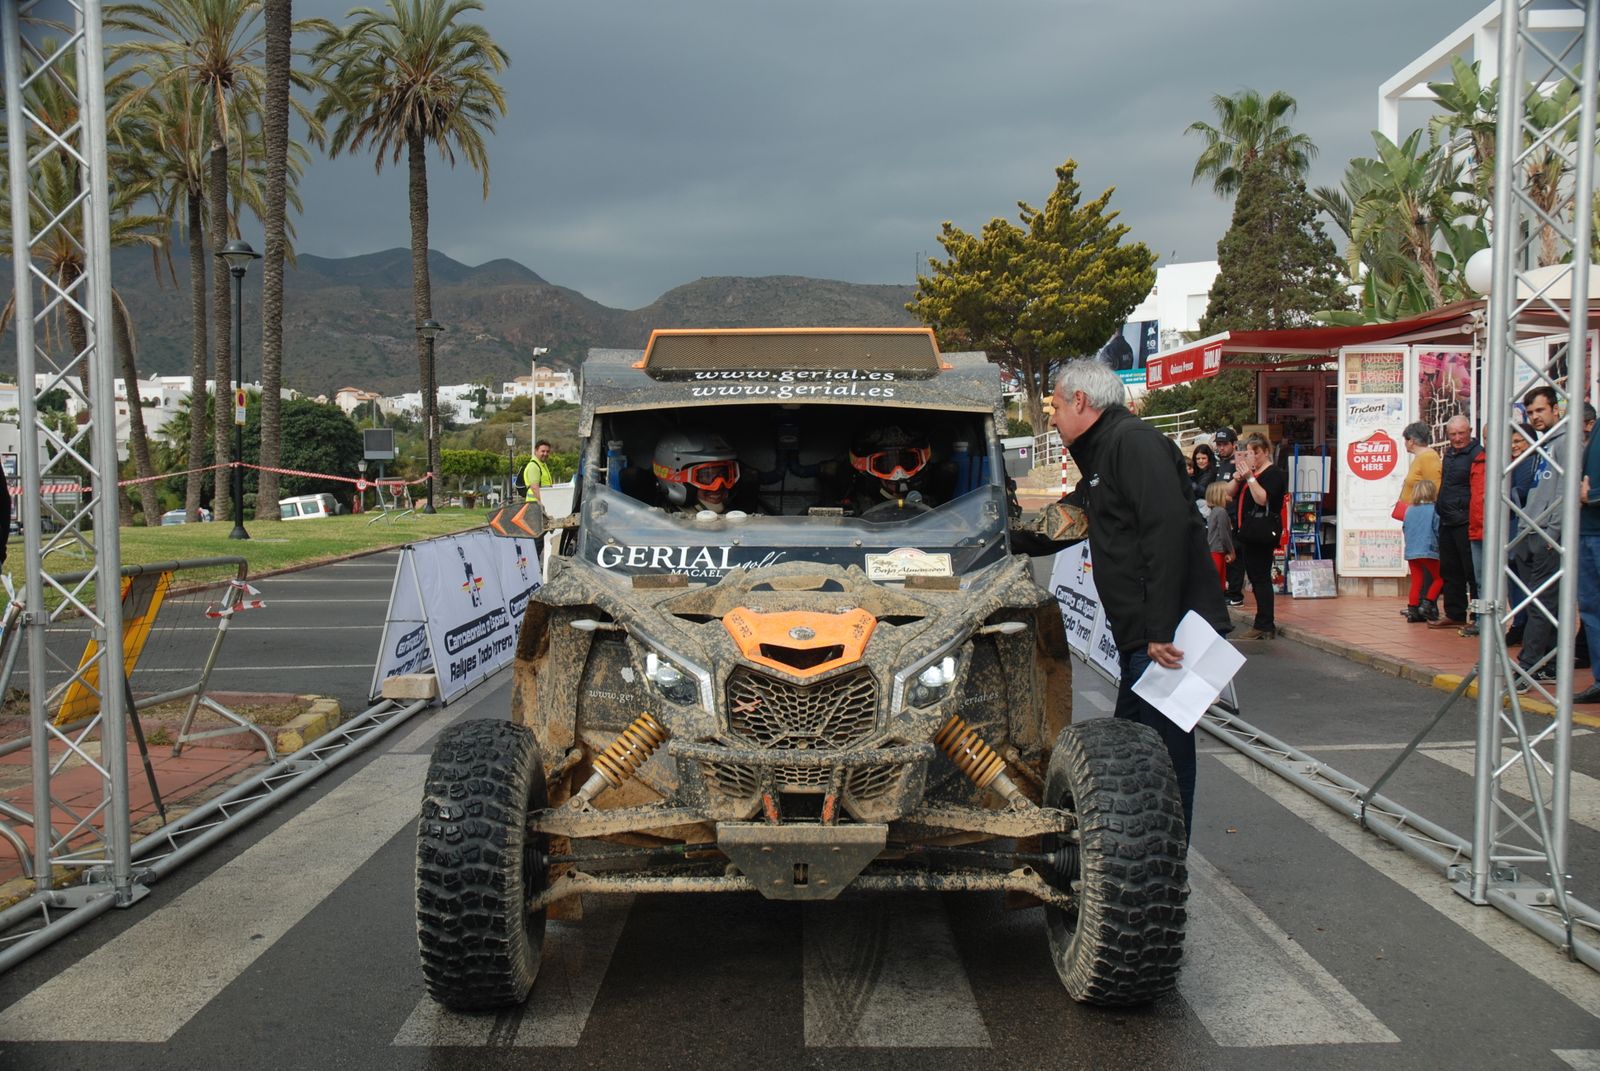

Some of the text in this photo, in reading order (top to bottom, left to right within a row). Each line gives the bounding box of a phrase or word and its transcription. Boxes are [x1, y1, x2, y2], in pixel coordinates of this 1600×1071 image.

[694, 369, 895, 382] www.gerial.es
[692, 382, 895, 399] www.gerial.es
[1349, 403, 1386, 415] Trident
[1353, 455, 1392, 463] ON SALE
[1361, 463, 1384, 471] HERE
[597, 544, 741, 569] GERIAL
[670, 568, 723, 578] MACAEL
[450, 654, 477, 682] Rallyes
